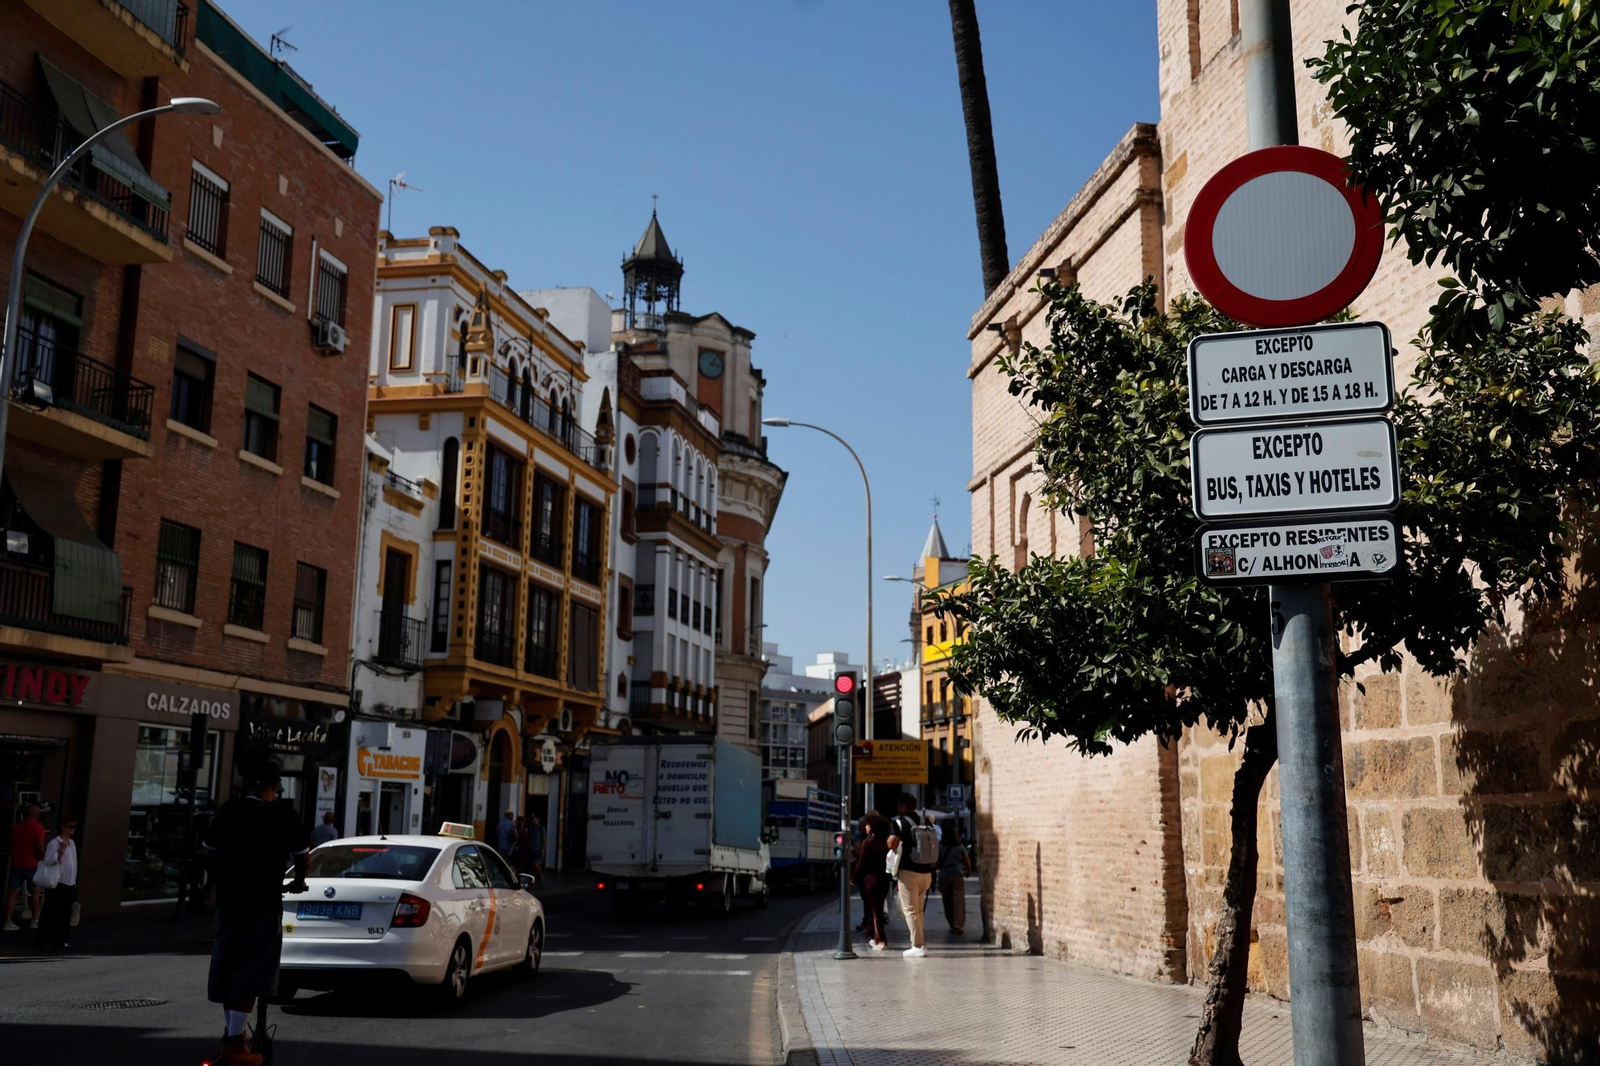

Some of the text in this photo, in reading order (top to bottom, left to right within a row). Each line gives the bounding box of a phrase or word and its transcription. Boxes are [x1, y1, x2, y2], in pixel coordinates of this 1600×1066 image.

[1255, 335, 1313, 355] EXCEPTO
[1221, 357, 1352, 384] CARGA Y DESCARGA
[1200, 381, 1379, 411] DE 7 A 12 H. Y DE 15 A 18 H.
[1252, 432, 1323, 460] EXCEPTO
[1206, 466, 1381, 505] BUS, TAXIS Y HOTELES
[1208, 531, 1281, 549] EXCEPTO
[1238, 551, 1361, 575] C/ ALHONA
[0, 662, 91, 706] INDY
[146, 692, 231, 719] CALZADOS
[373, 753, 420, 771] TABACOS
[593, 784, 625, 794] RETO
[605, 770, 629, 786] NO
[306, 905, 359, 916] 9038 KNB
[367, 927, 385, 935] 1843
